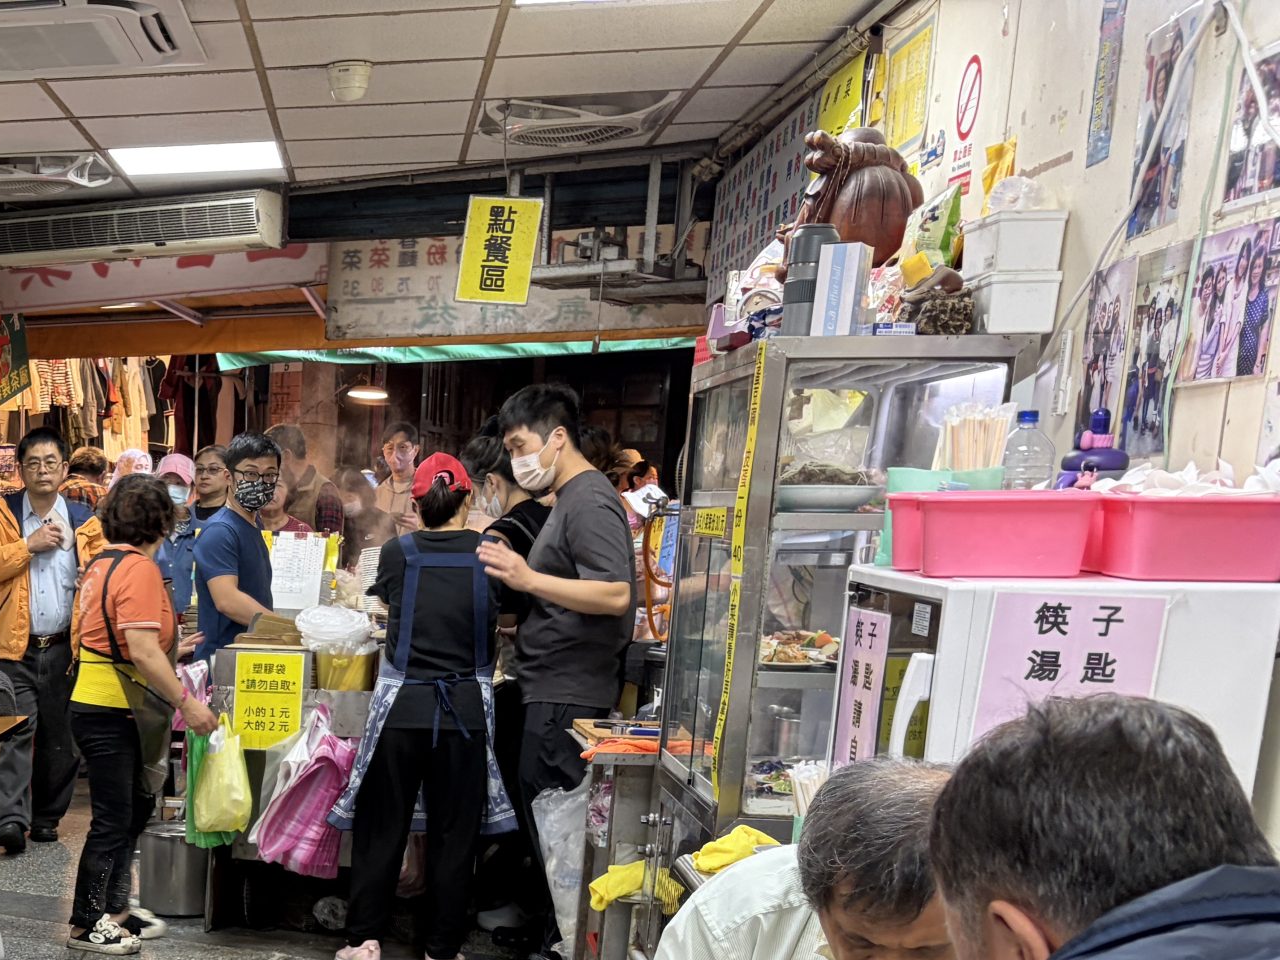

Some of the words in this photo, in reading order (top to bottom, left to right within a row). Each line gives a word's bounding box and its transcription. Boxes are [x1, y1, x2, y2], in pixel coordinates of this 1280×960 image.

[479, 205, 516, 292] 點餐區
[1034, 602, 1124, 637] 筷子
[252, 663, 285, 674] 塑膠袋
[1024, 650, 1117, 685] 湯匙
